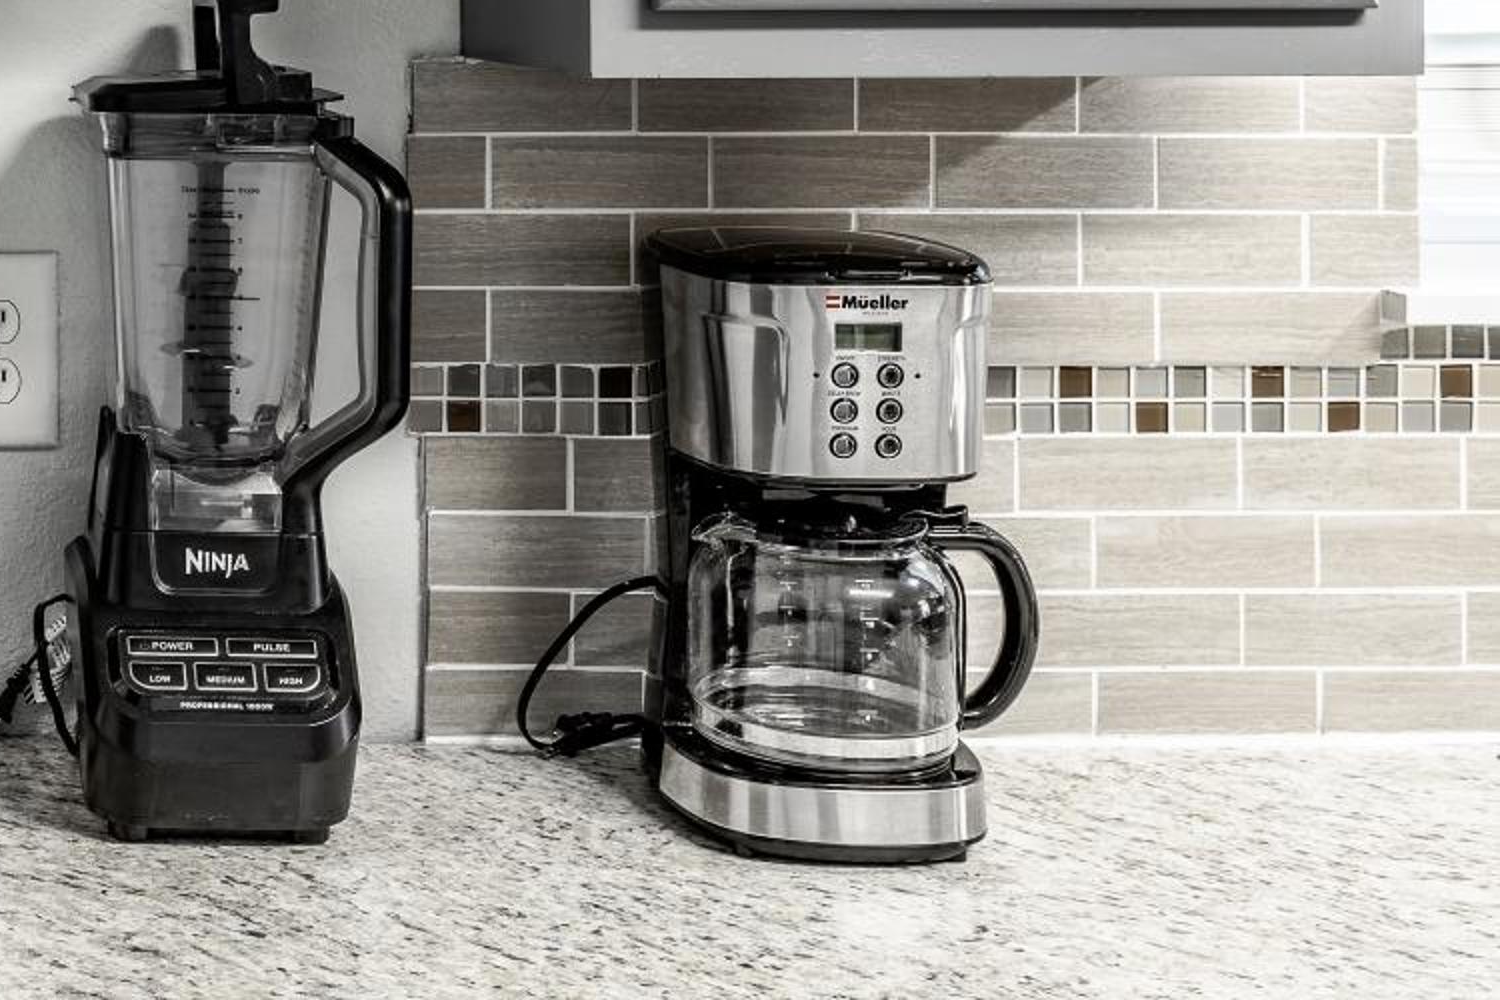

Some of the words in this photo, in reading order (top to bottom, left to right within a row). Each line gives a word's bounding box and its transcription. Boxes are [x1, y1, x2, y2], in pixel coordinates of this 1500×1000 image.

[185, 547, 250, 579] NINJA
[152, 641, 193, 651] POWER
[253, 643, 290, 653] PULSE
[149, 674, 171, 684] LOW
[206, 675, 245, 685] MEDIUM
[279, 676, 303, 686] HIGH
